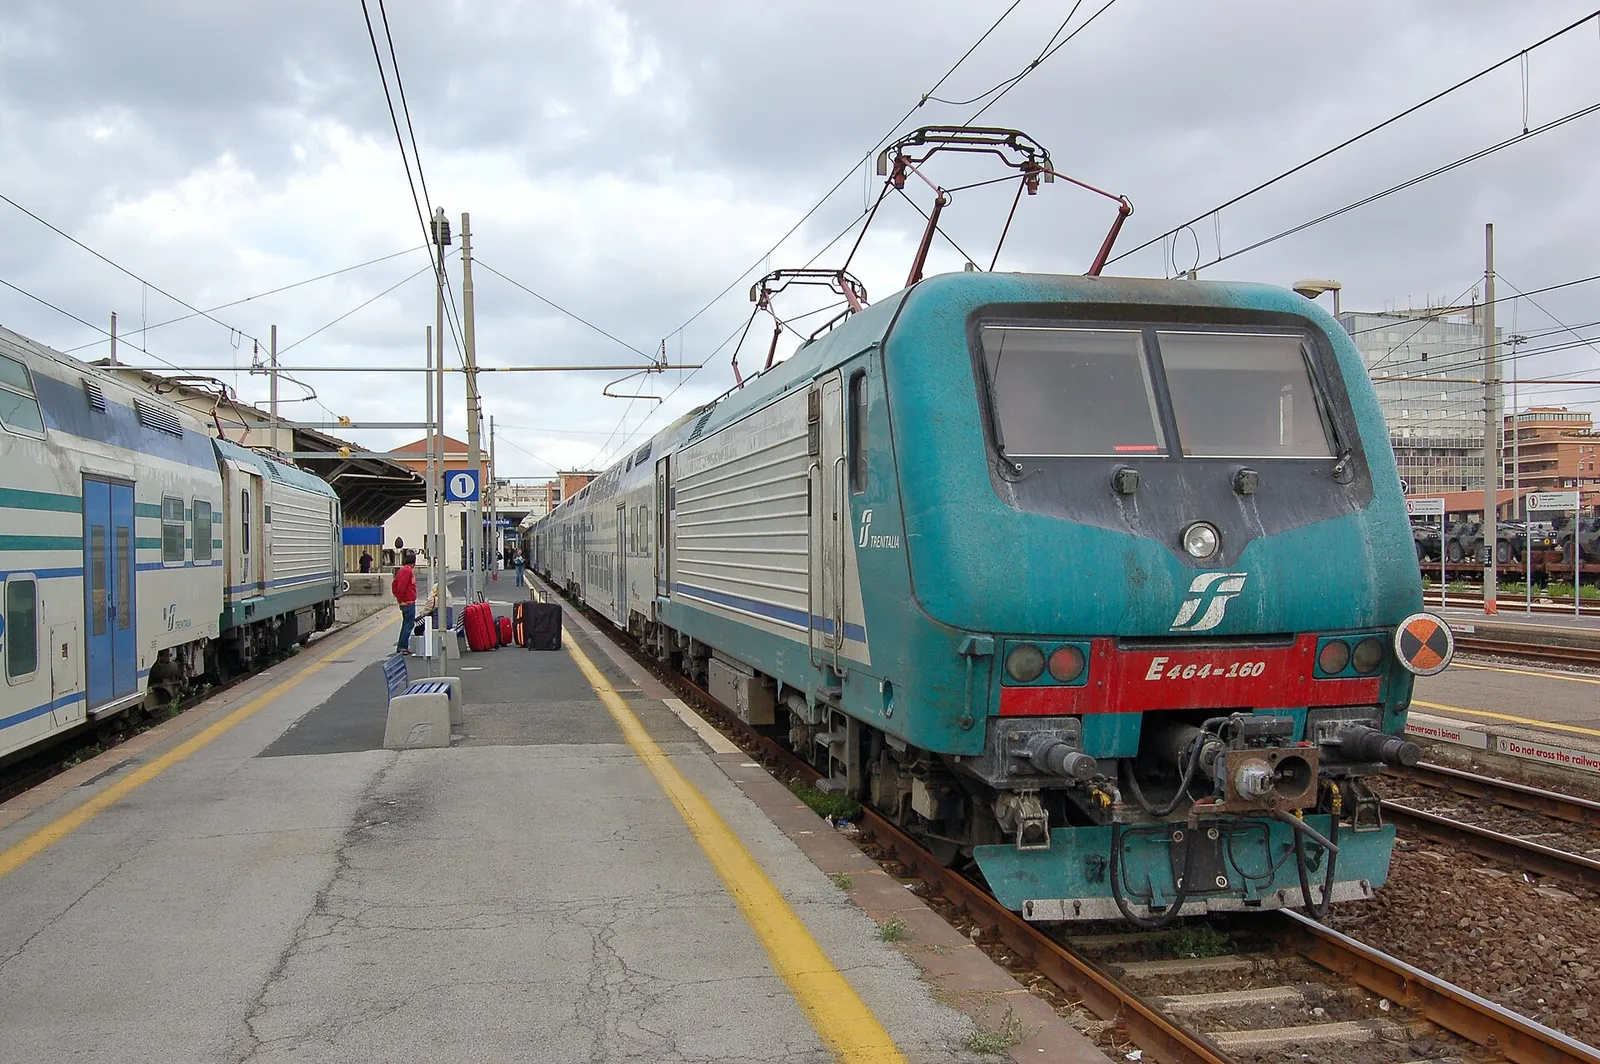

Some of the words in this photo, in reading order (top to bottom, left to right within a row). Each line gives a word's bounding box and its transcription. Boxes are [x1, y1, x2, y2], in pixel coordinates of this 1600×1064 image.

[458, 477, 467, 494] 1
[870, 535, 900, 549] TRENITALIA
[1166, 661, 1265, 680] 464-160
[1438, 728, 1441, 737] i
[1441, 728, 1460, 740] binari
[1510, 742, 1520, 752] Do
[1521, 745, 1535, 755] not
[1536, 751, 1554, 760] cross
[1556, 751, 1569, 762] the
